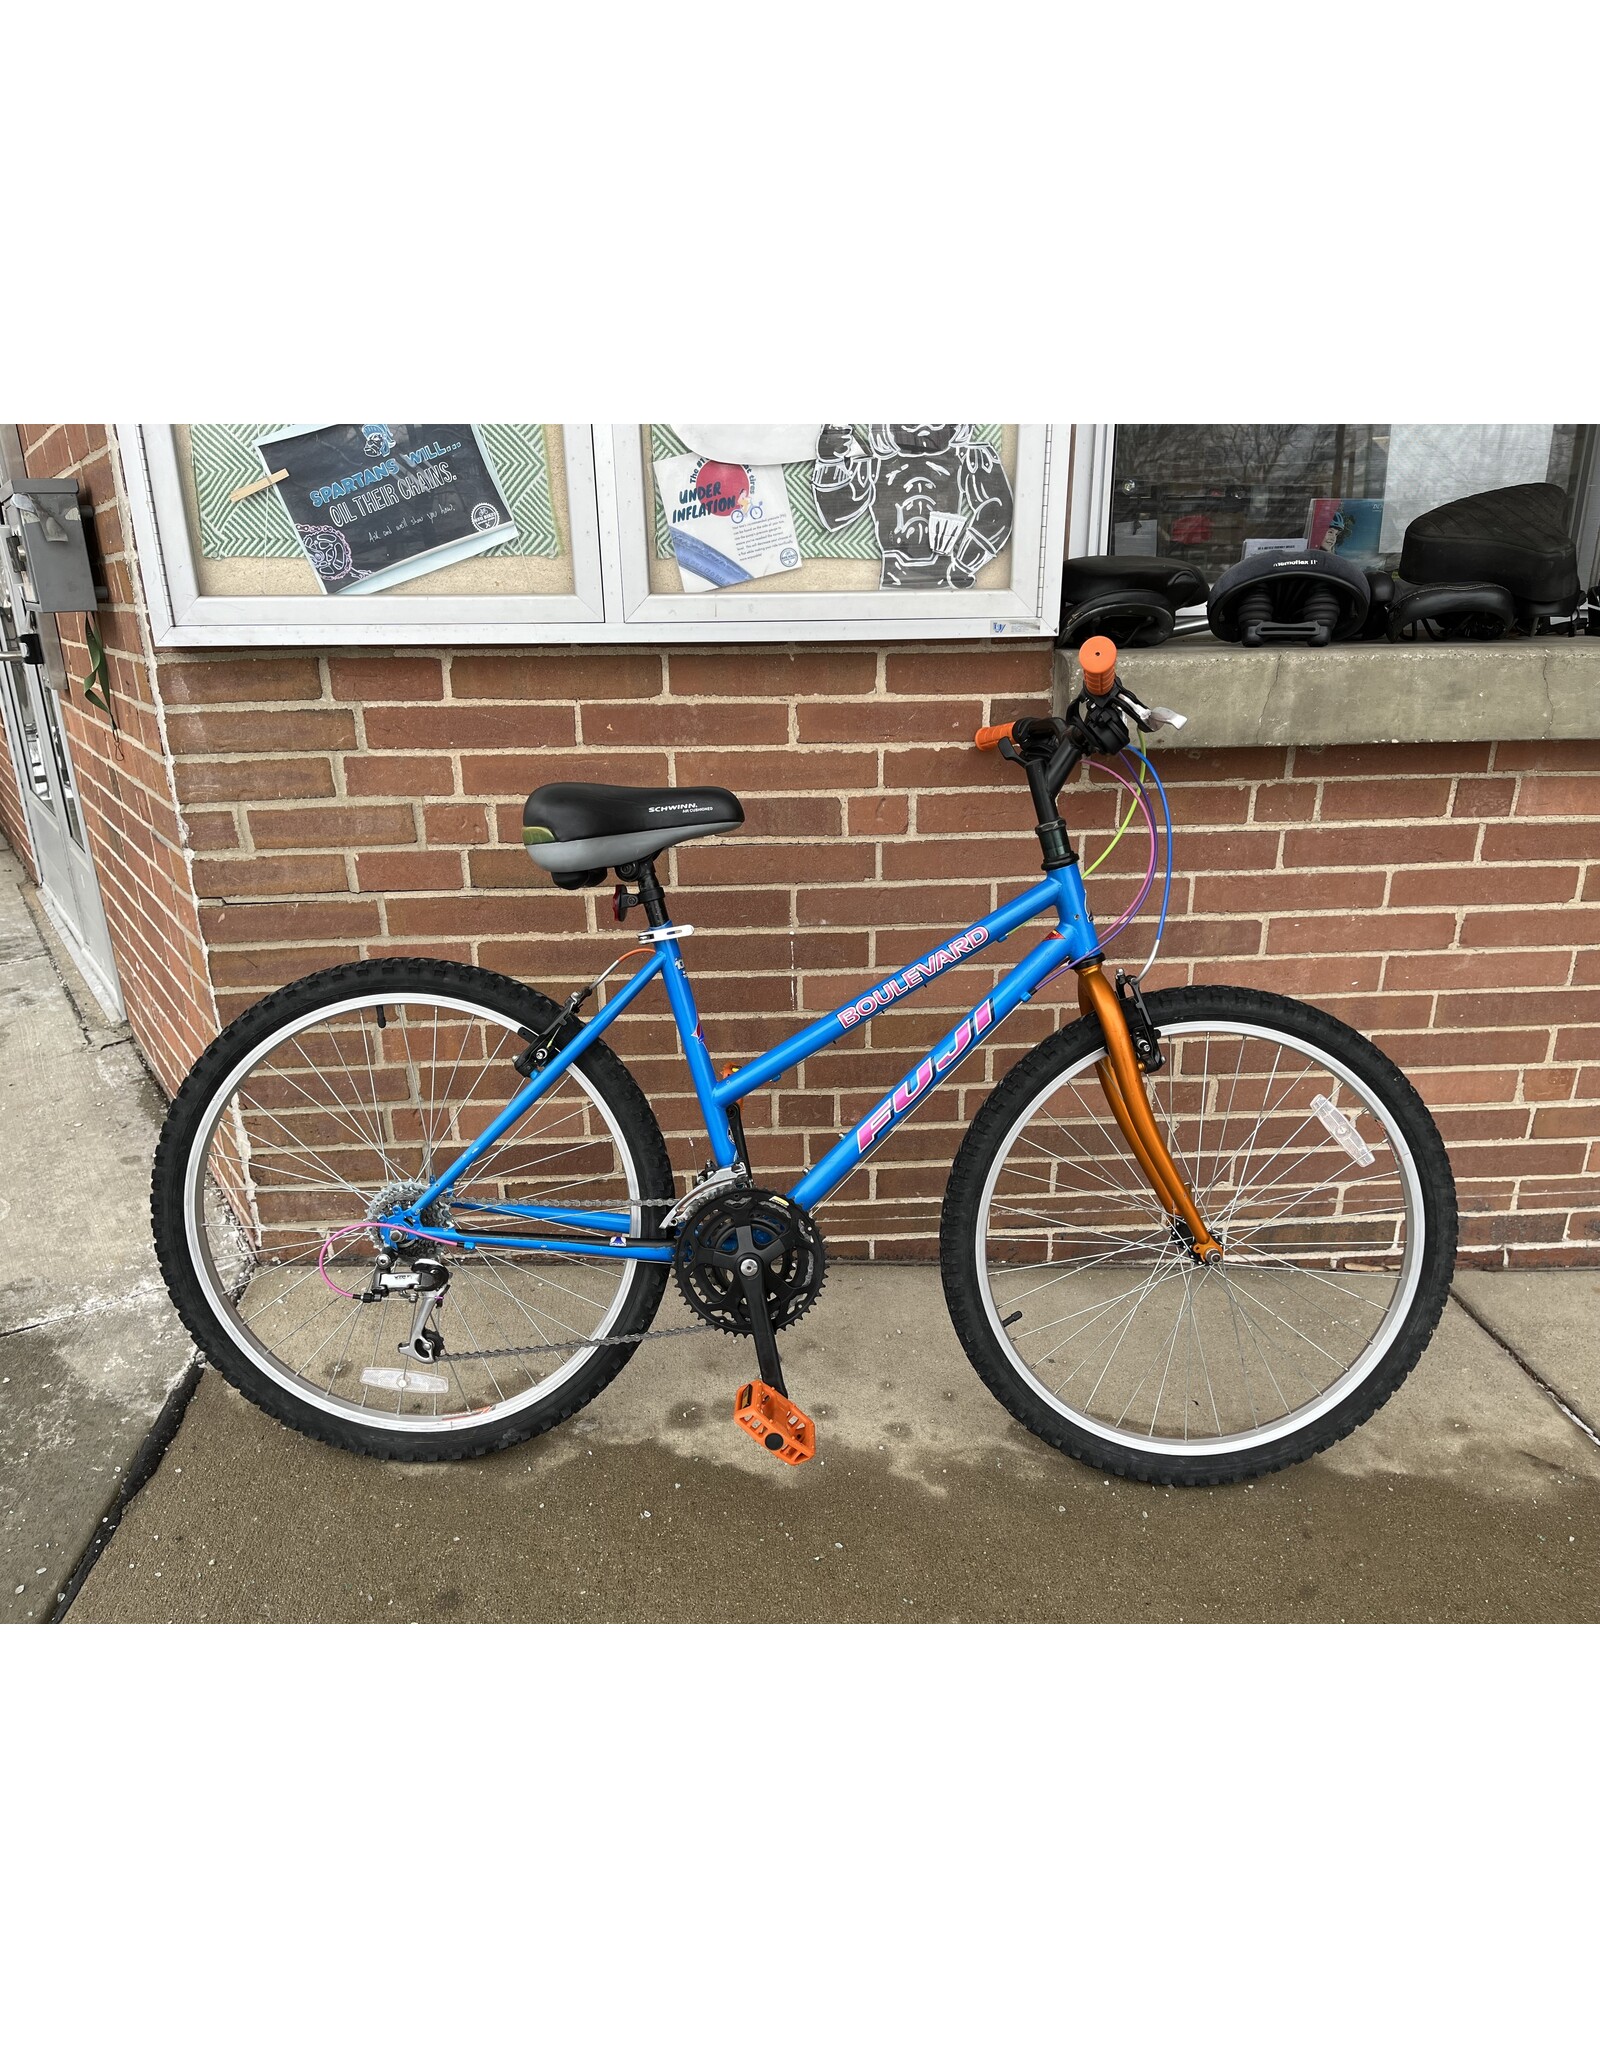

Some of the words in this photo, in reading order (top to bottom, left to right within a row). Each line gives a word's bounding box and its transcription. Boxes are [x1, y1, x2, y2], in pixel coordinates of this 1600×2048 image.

[309, 457, 400, 508] SPARTANS
[329, 501, 358, 528] OIL
[352, 483, 400, 518] THEIR
[397, 461, 458, 500] CHAINS.
[672, 495, 736, 524] INFLATION
[679, 481, 721, 504] UNDER
[836, 925, 990, 1030] BOULEVARD
[856, 998, 997, 1155] FUJI
